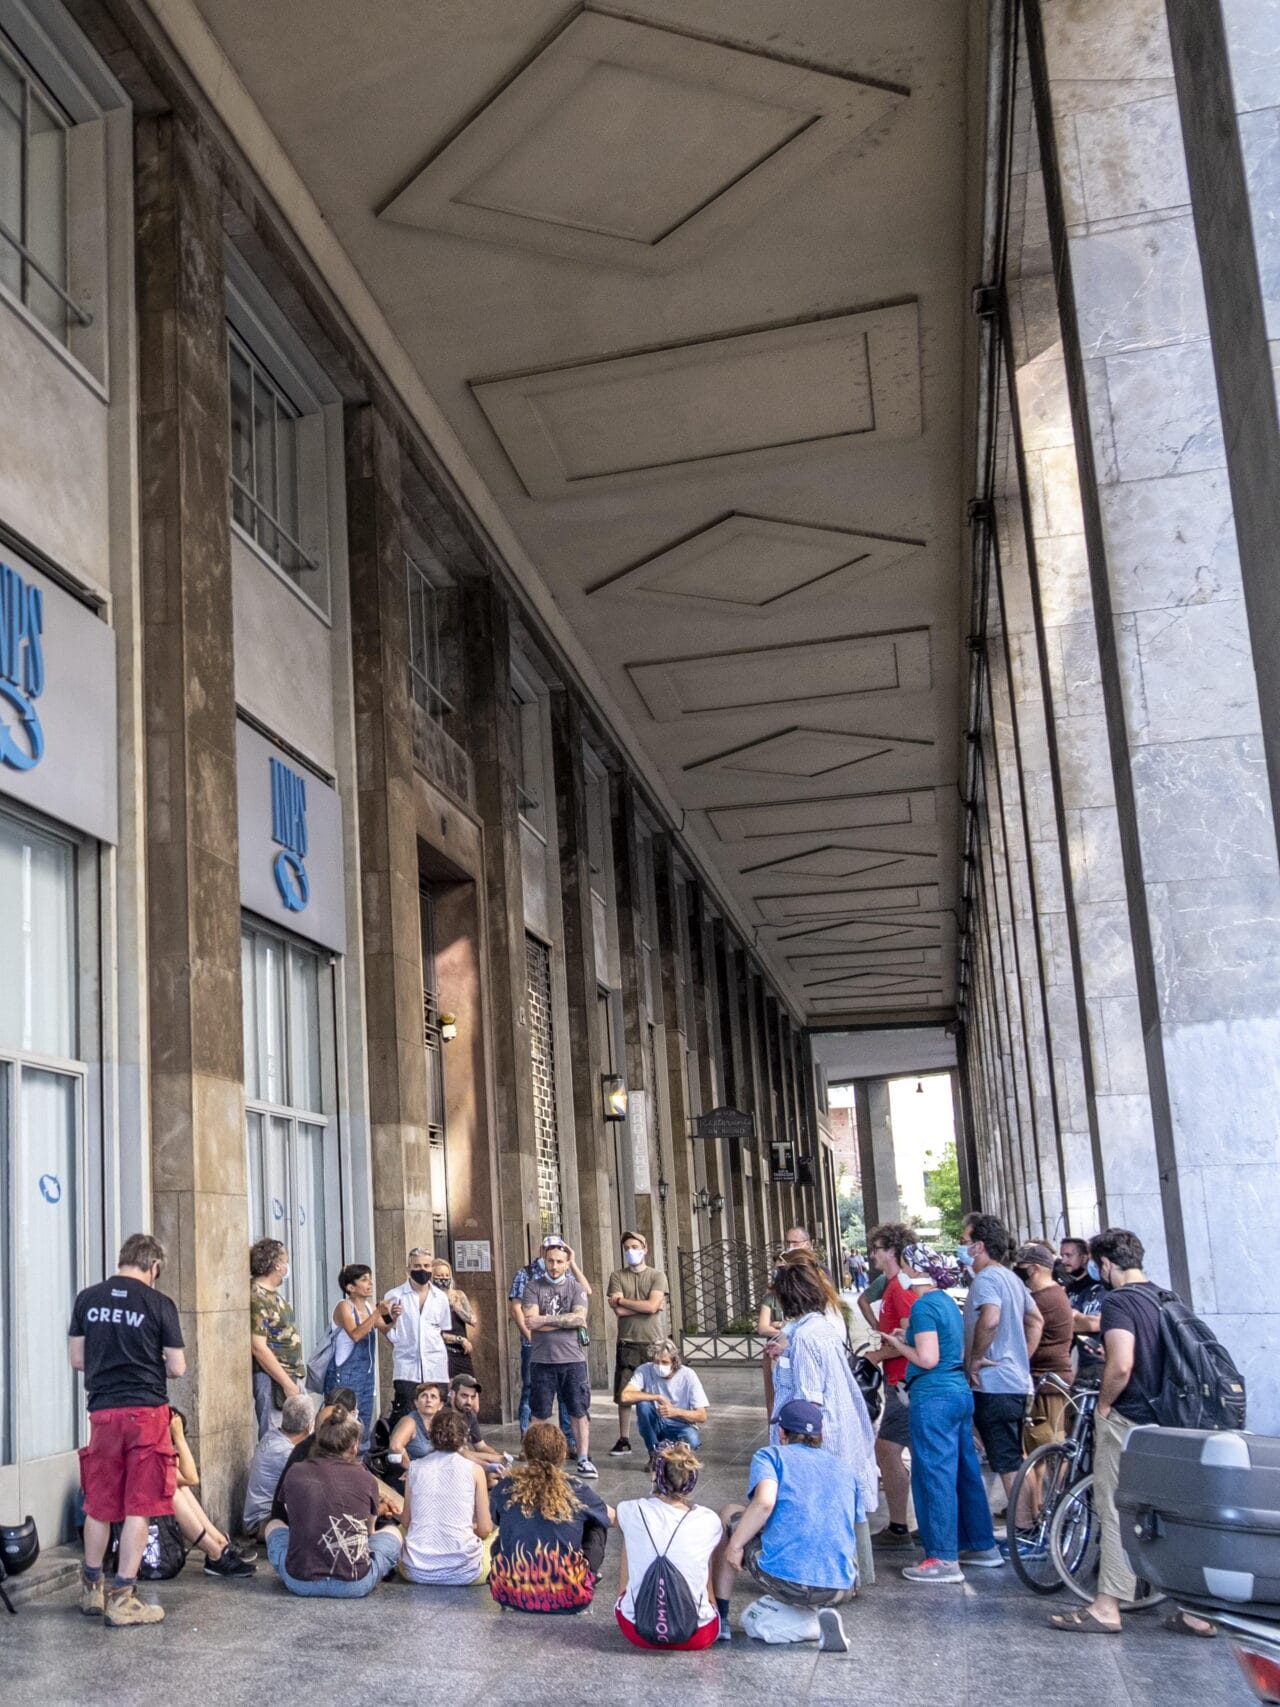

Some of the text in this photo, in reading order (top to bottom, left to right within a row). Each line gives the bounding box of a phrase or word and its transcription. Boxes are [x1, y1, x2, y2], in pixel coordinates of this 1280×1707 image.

[269, 757, 309, 858] INPS
[772, 1142, 792, 1169] T
[87, 1307, 145, 1328] CREW
